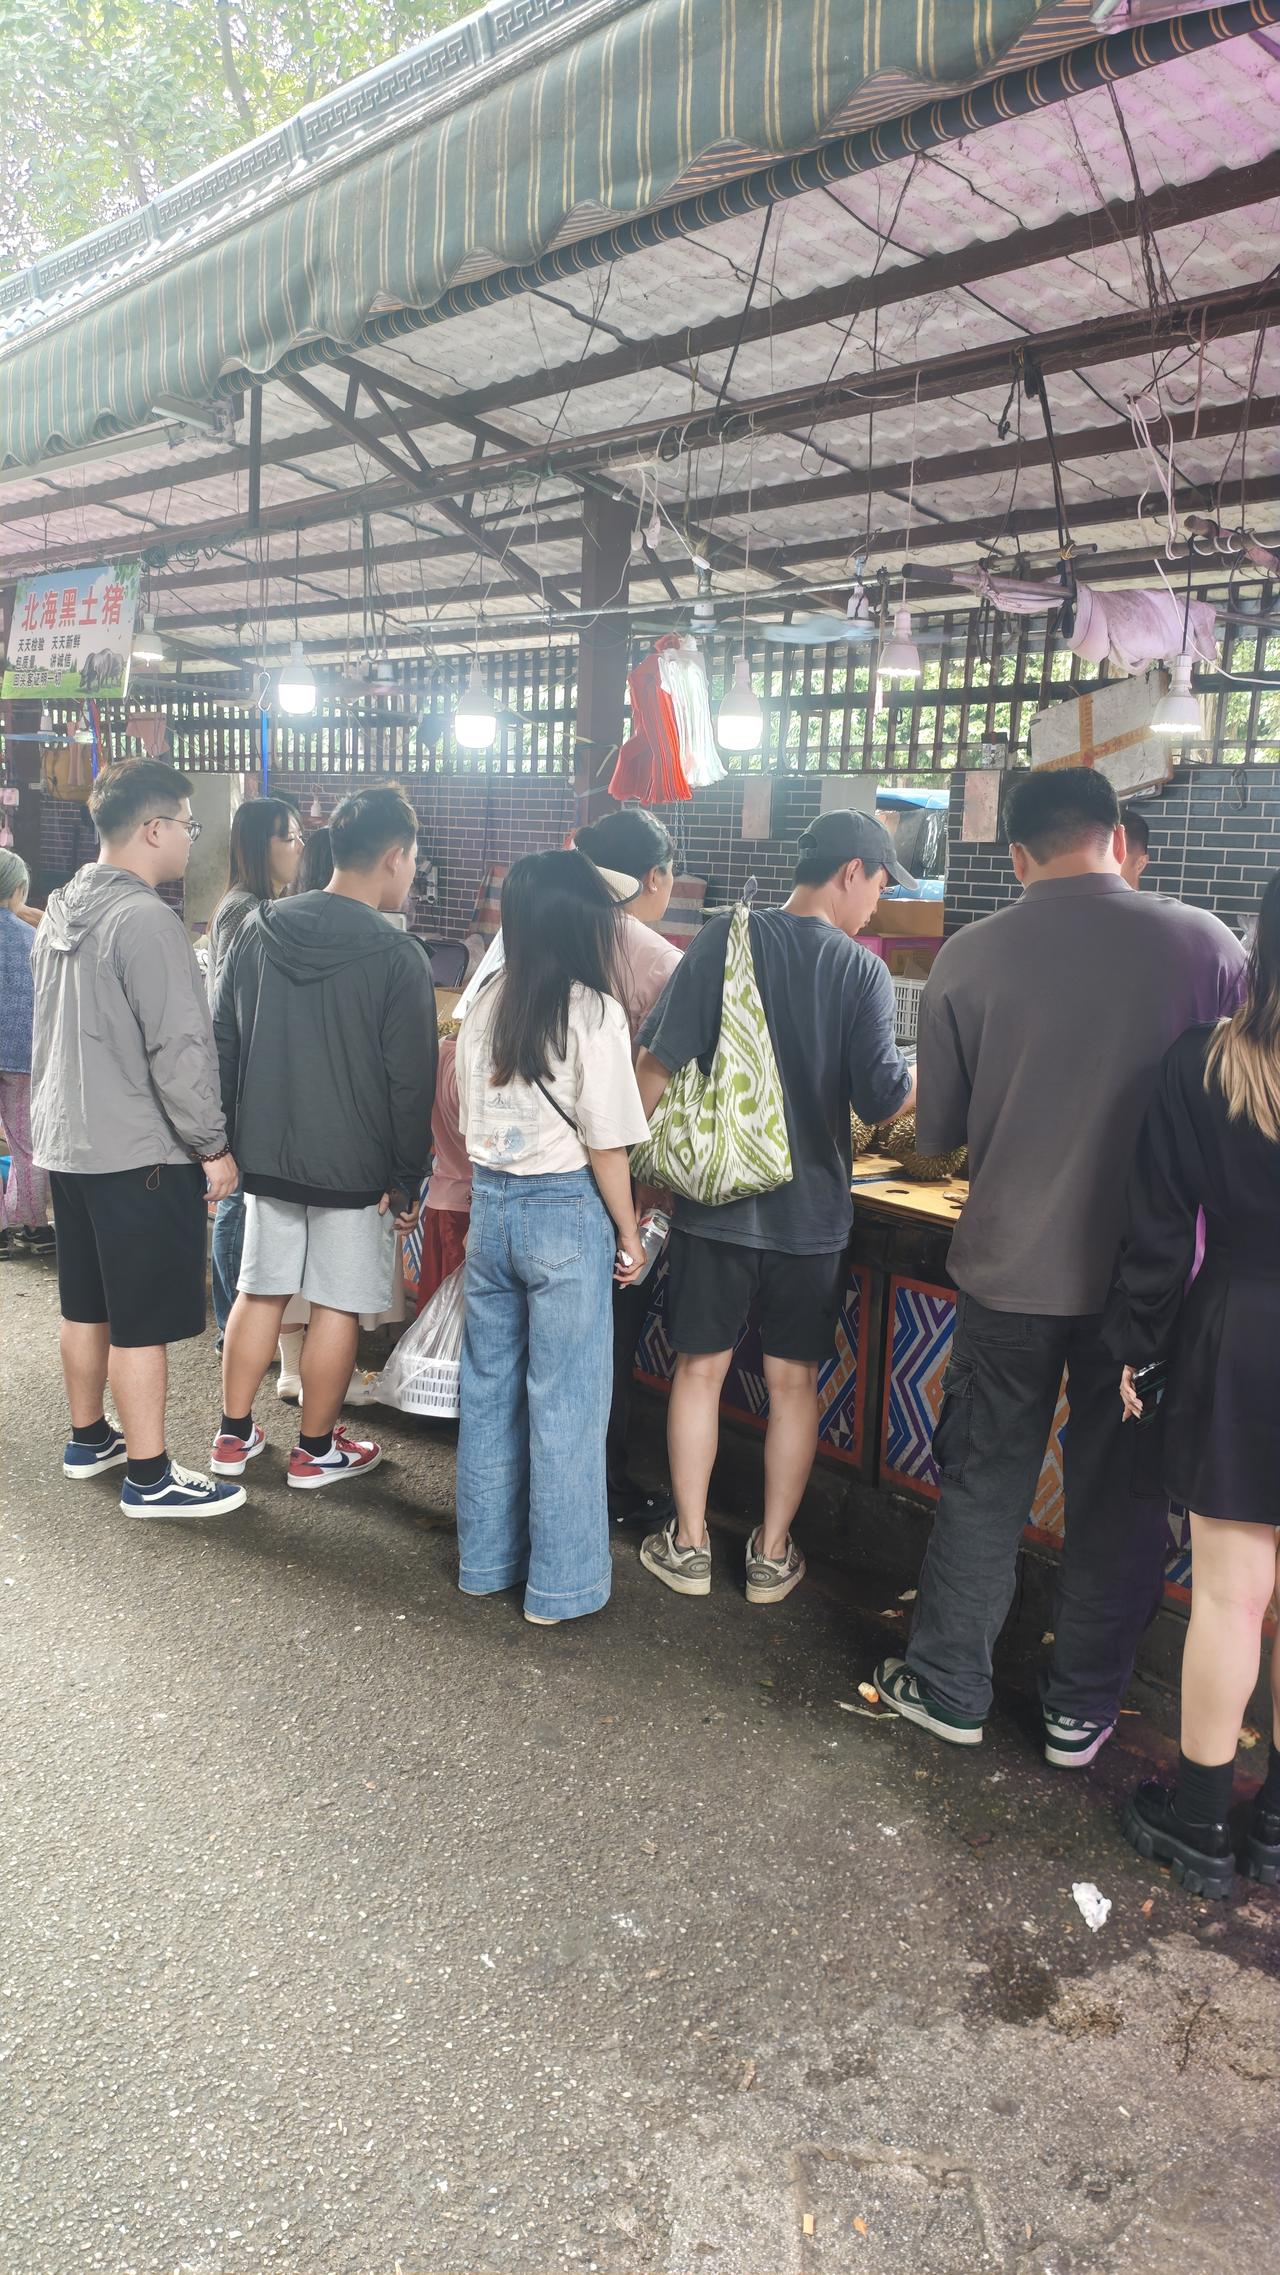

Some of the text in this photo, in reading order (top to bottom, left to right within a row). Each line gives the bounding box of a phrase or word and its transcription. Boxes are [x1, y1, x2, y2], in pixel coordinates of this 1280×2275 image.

[21, 584, 124, 631] 北海黑土猪
[17, 635, 80, 652] 天天检验 天天新鲜
[13, 671, 62, 687] 回头客证明一切
[1057, 1715, 1077, 1727] NIKE
